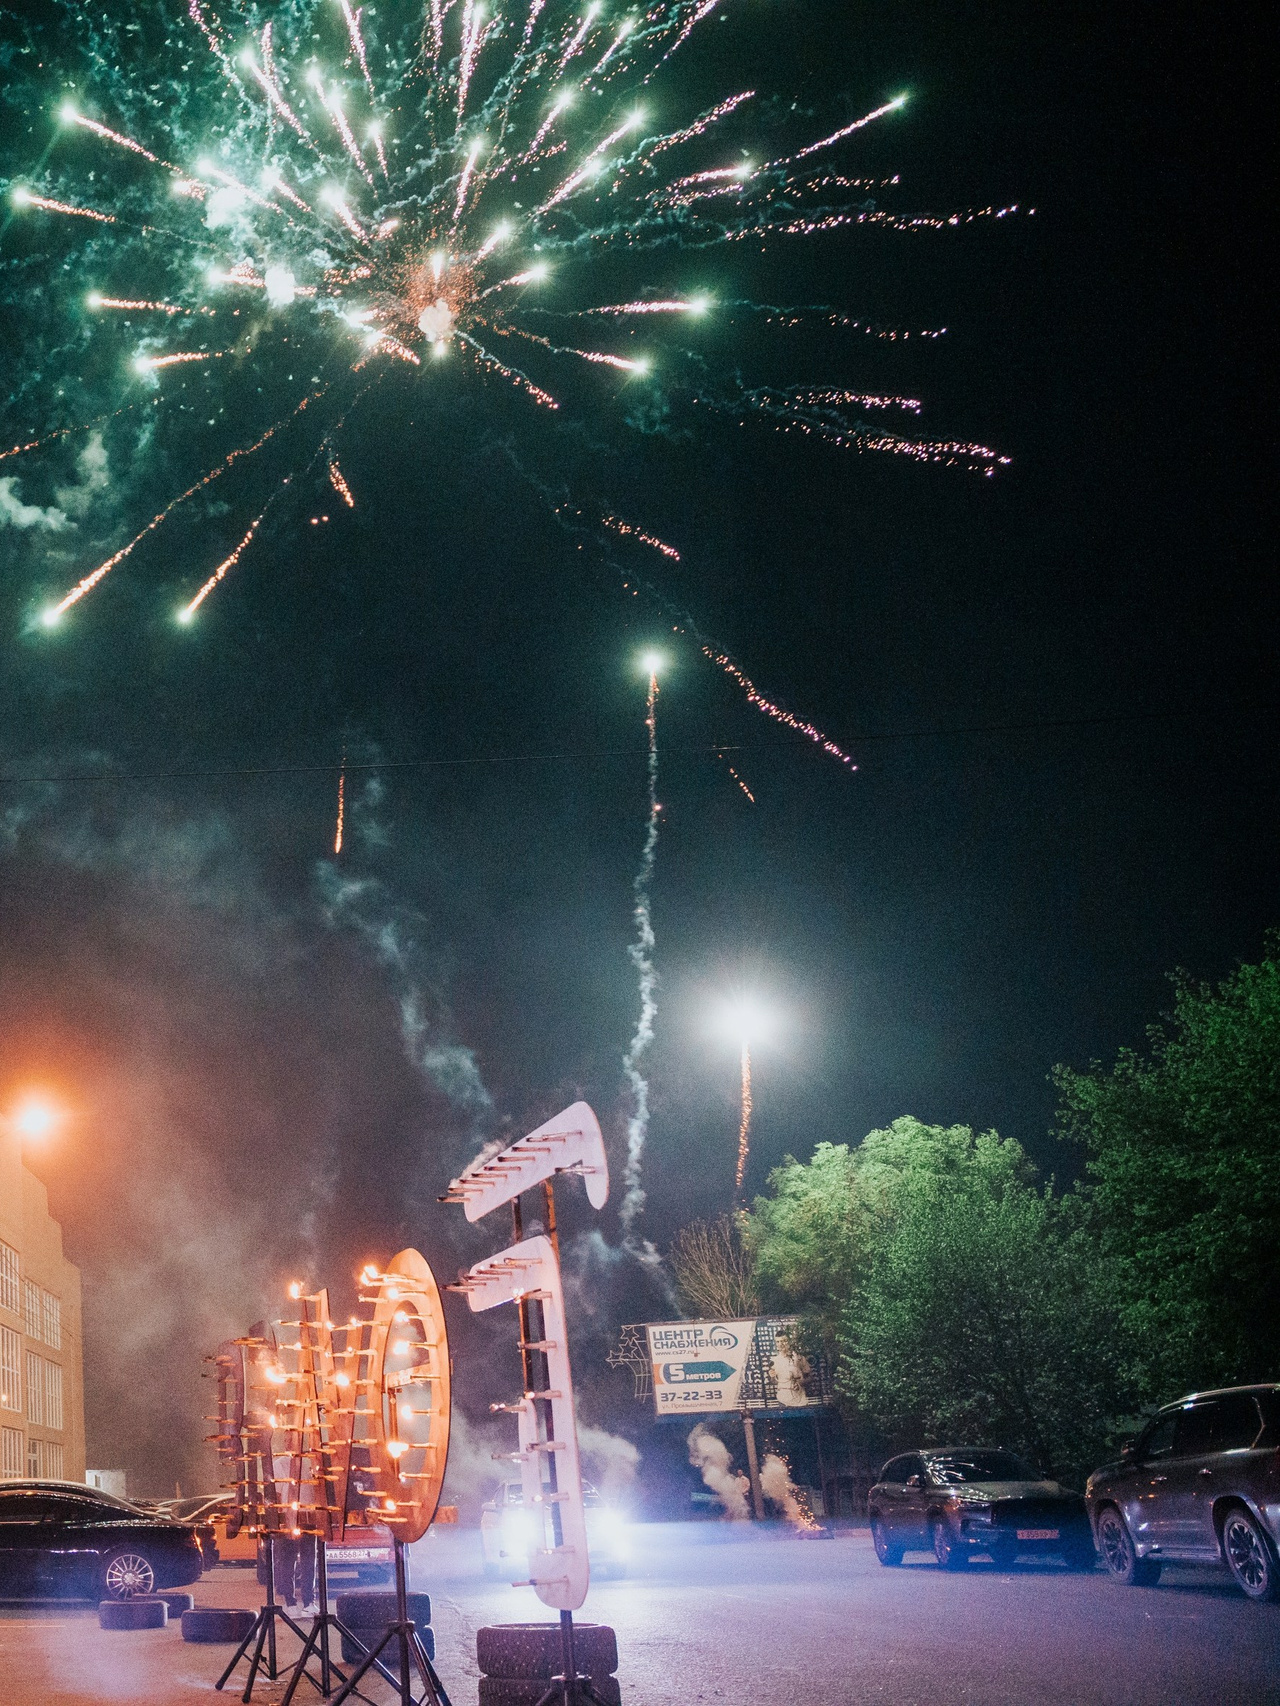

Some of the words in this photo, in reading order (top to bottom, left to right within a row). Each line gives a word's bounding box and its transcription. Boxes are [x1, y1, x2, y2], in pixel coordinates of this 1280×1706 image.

[652, 1329, 704, 1342] ЦЕНТР
[653, 1337, 731, 1350] СНАБЖЕНИЯ
[669, 1363, 685, 1382] 5
[685, 1372, 722, 1381] метров
[660, 1390, 723, 1402] 37-22-33
